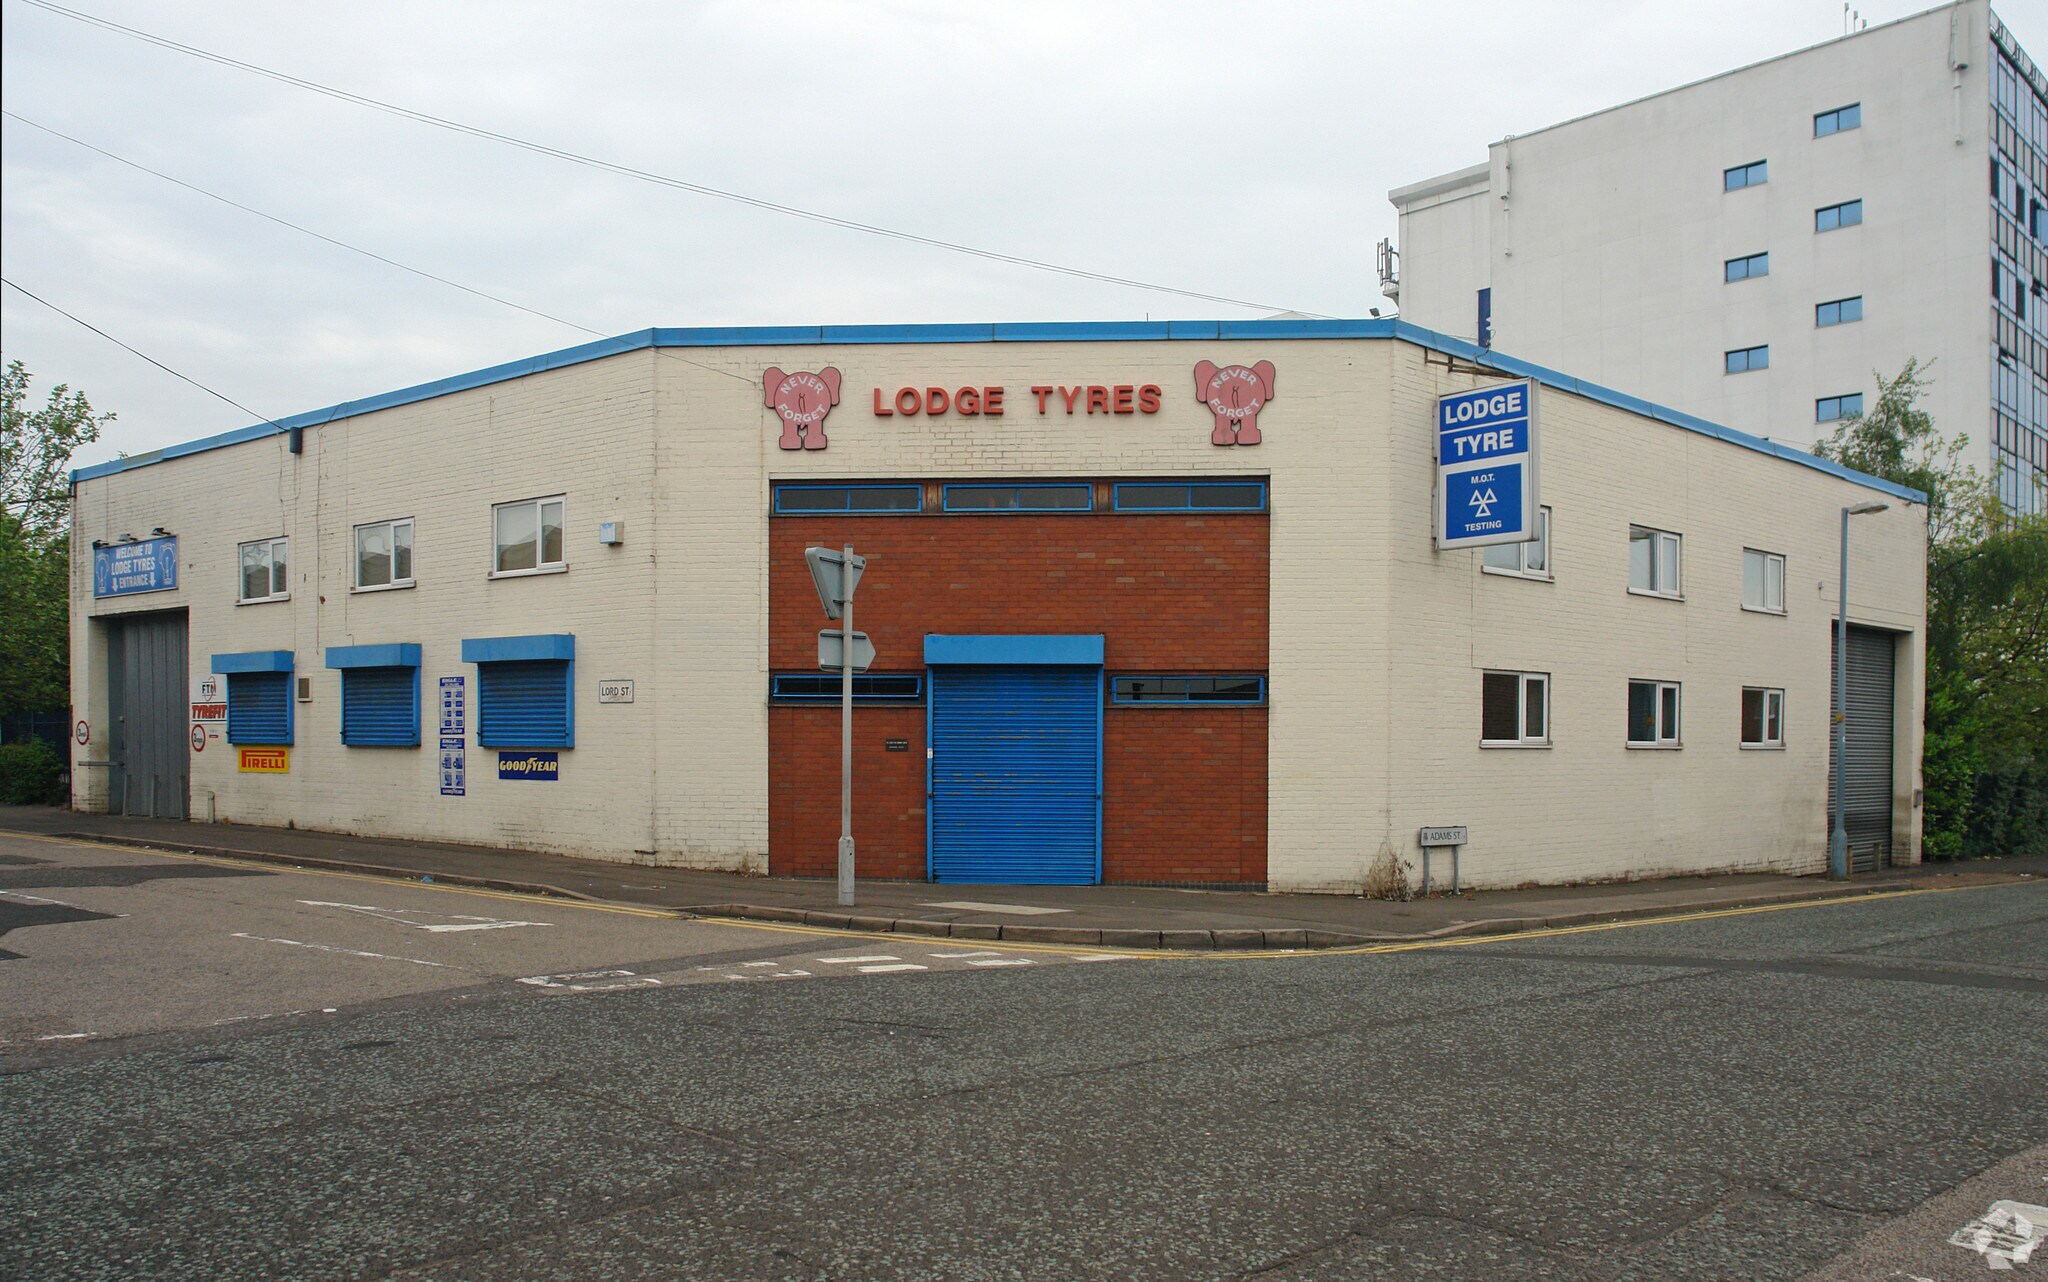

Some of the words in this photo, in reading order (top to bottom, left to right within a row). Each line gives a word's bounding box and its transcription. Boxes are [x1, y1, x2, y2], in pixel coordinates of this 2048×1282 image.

[780, 375, 824, 395] NEVER
[1212, 369, 1257, 389] NEVER
[873, 386, 1005, 416] LODGE
[1031, 384, 1163, 415] TYRES
[1210, 398, 1260, 417] FORGET
[1445, 391, 1522, 425] LODGE
[778, 403, 826, 422] FORGET
[1454, 428, 1514, 457] TYRE
[1471, 473, 1496, 485] M.O.T.
[1465, 520, 1502, 532] TESTING
[116, 545, 144, 560] WELCOME
[145, 543, 153, 555] TO
[111, 560, 132, 576] LODGE
[133, 557, 156, 573] TYRES
[119, 574, 149, 589] ENTRANCE
[601, 686, 619, 697] LORD
[192, 704, 228, 719] TYREFIT
[241, 749, 285, 769] PIRELLI
[1430, 831, 1452, 841] ADAMS
[1453, 831, 1461, 840] ST
